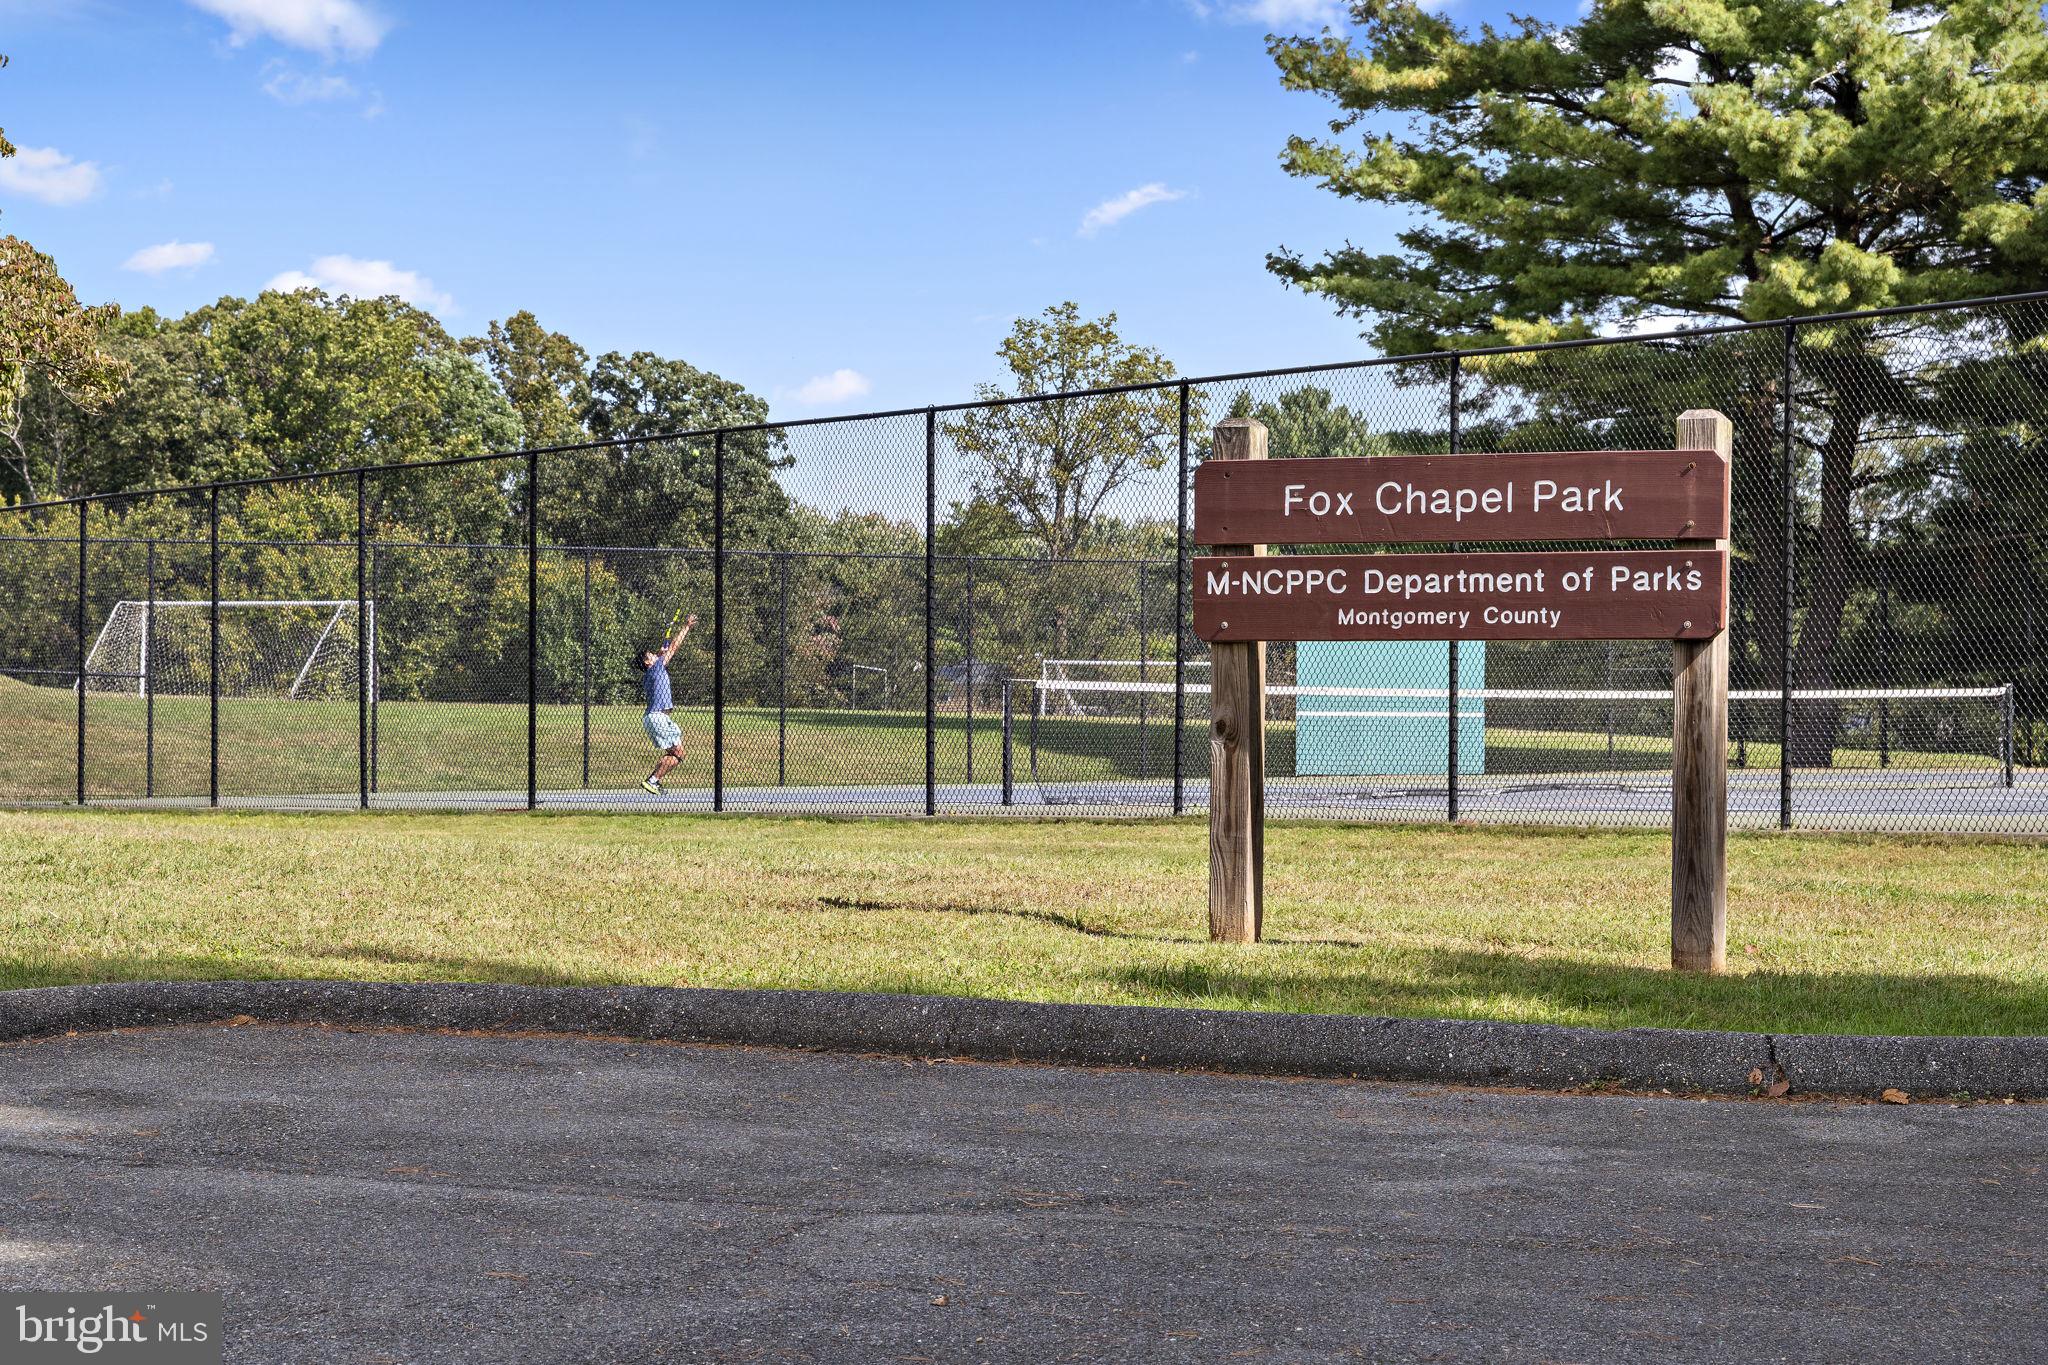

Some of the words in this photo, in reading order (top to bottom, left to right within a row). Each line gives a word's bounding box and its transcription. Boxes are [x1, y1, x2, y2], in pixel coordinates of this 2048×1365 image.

[1283, 483, 1354, 517] Fox
[1374, 480, 1514, 522] Chapel
[1532, 479, 1625, 513] Park
[1206, 568, 1348, 597] M-NCPPC
[1363, 568, 1546, 600] Department
[1560, 566, 1594, 592] of
[1610, 564, 1703, 592] Parks
[1337, 607, 1471, 630] Montgomery
[1482, 606, 1562, 630] County
